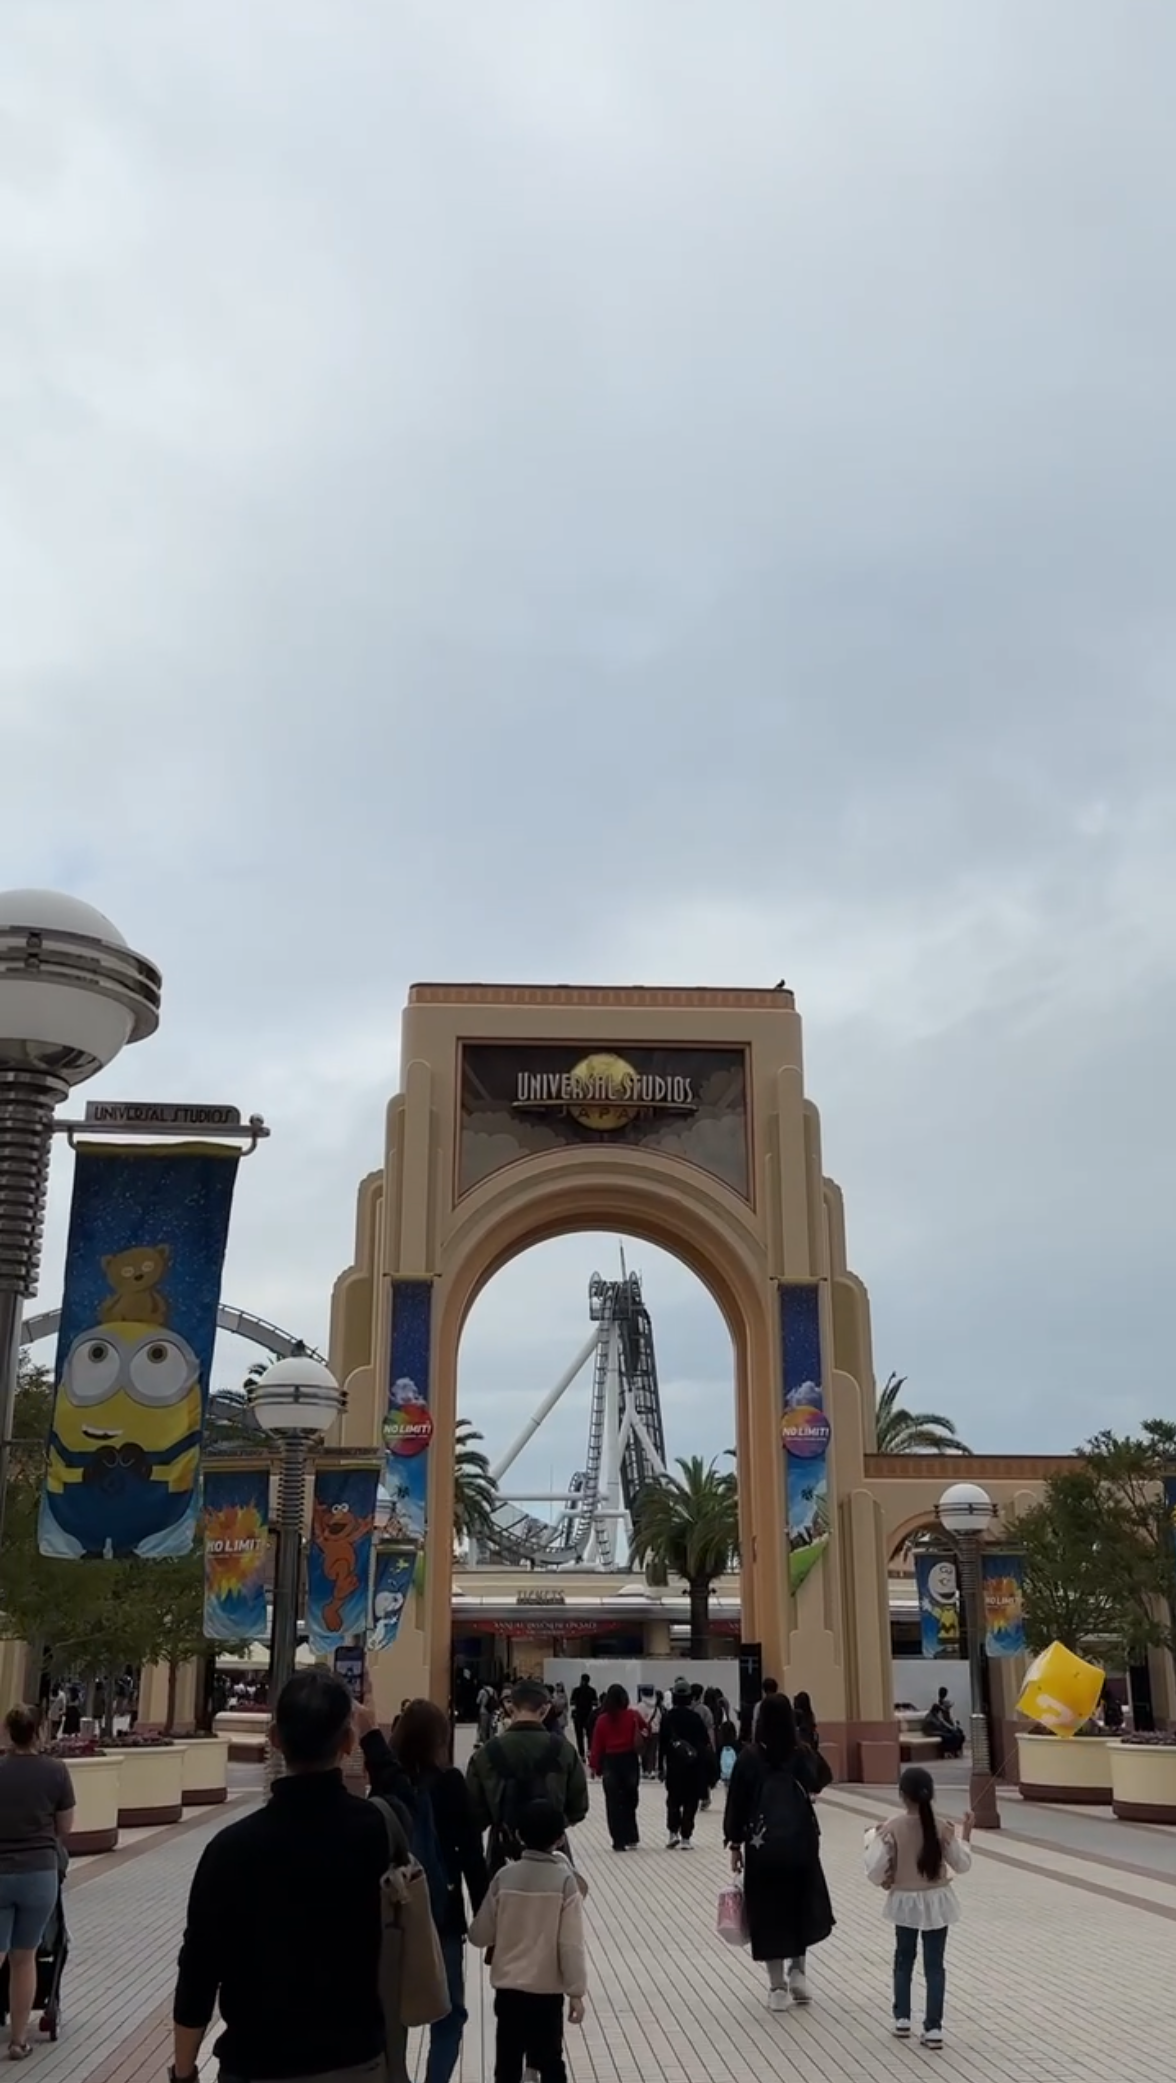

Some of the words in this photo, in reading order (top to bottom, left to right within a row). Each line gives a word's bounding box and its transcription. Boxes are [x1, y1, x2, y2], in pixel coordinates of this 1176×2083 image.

[517, 1072, 618, 1100] UNIVERSAL
[621, 1074, 693, 1103] STUDIOS
[94, 1105, 168, 1123] UNIVERSAL
[169, 1107, 233, 1125] STUDIOS
[383, 1425, 398, 1434] NO
[782, 1427, 797, 1436] NO
[206, 1540, 223, 1552] NO
[516, 1589, 565, 1604] TICKETS
